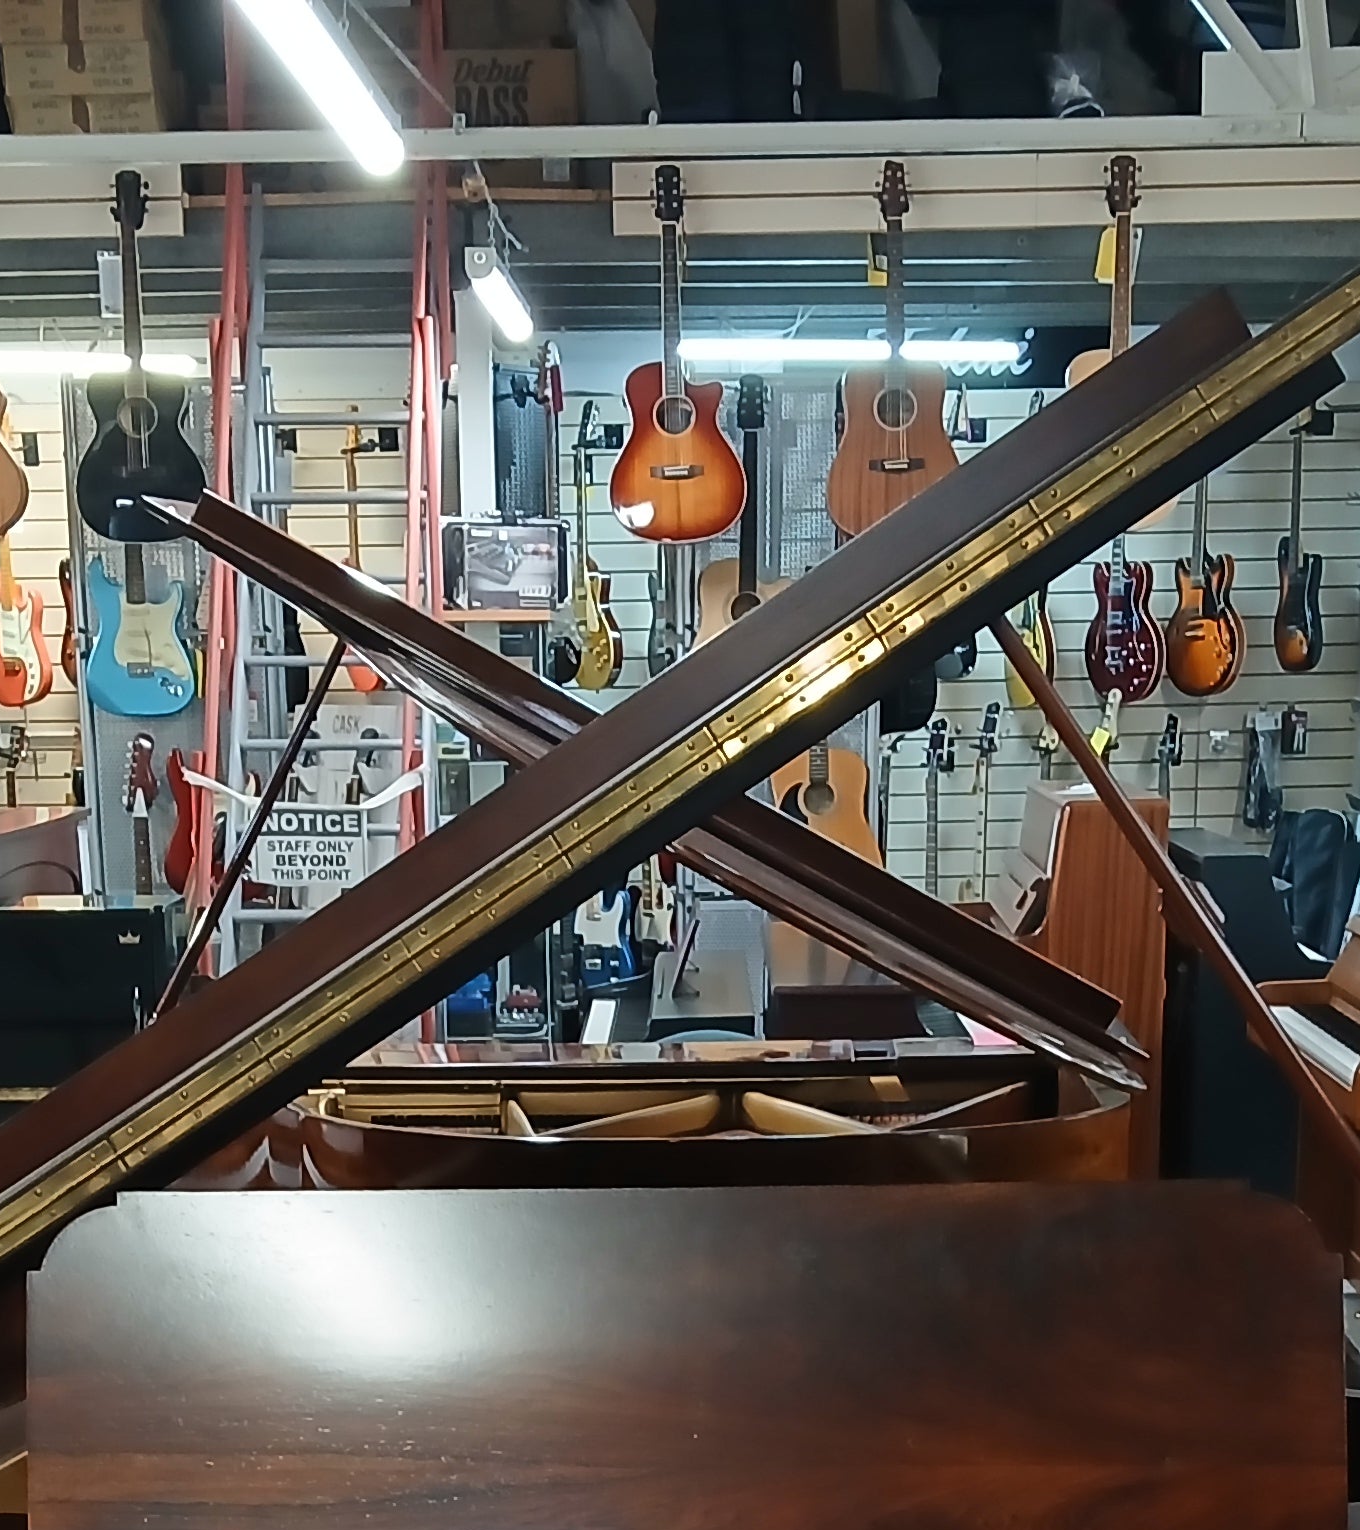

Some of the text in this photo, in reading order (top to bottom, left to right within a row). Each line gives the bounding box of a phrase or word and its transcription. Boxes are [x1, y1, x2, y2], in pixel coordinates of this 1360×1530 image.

[454, 56, 534, 84] Debut
[455, 84, 529, 126] BASS
[332, 715, 362, 734] CASK
[262, 812, 360, 833] NOTICE
[267, 840, 354, 852] STAFF ONLY
[276, 854, 346, 867] BEYOND
[272, 868, 351, 881] THIS POINT
